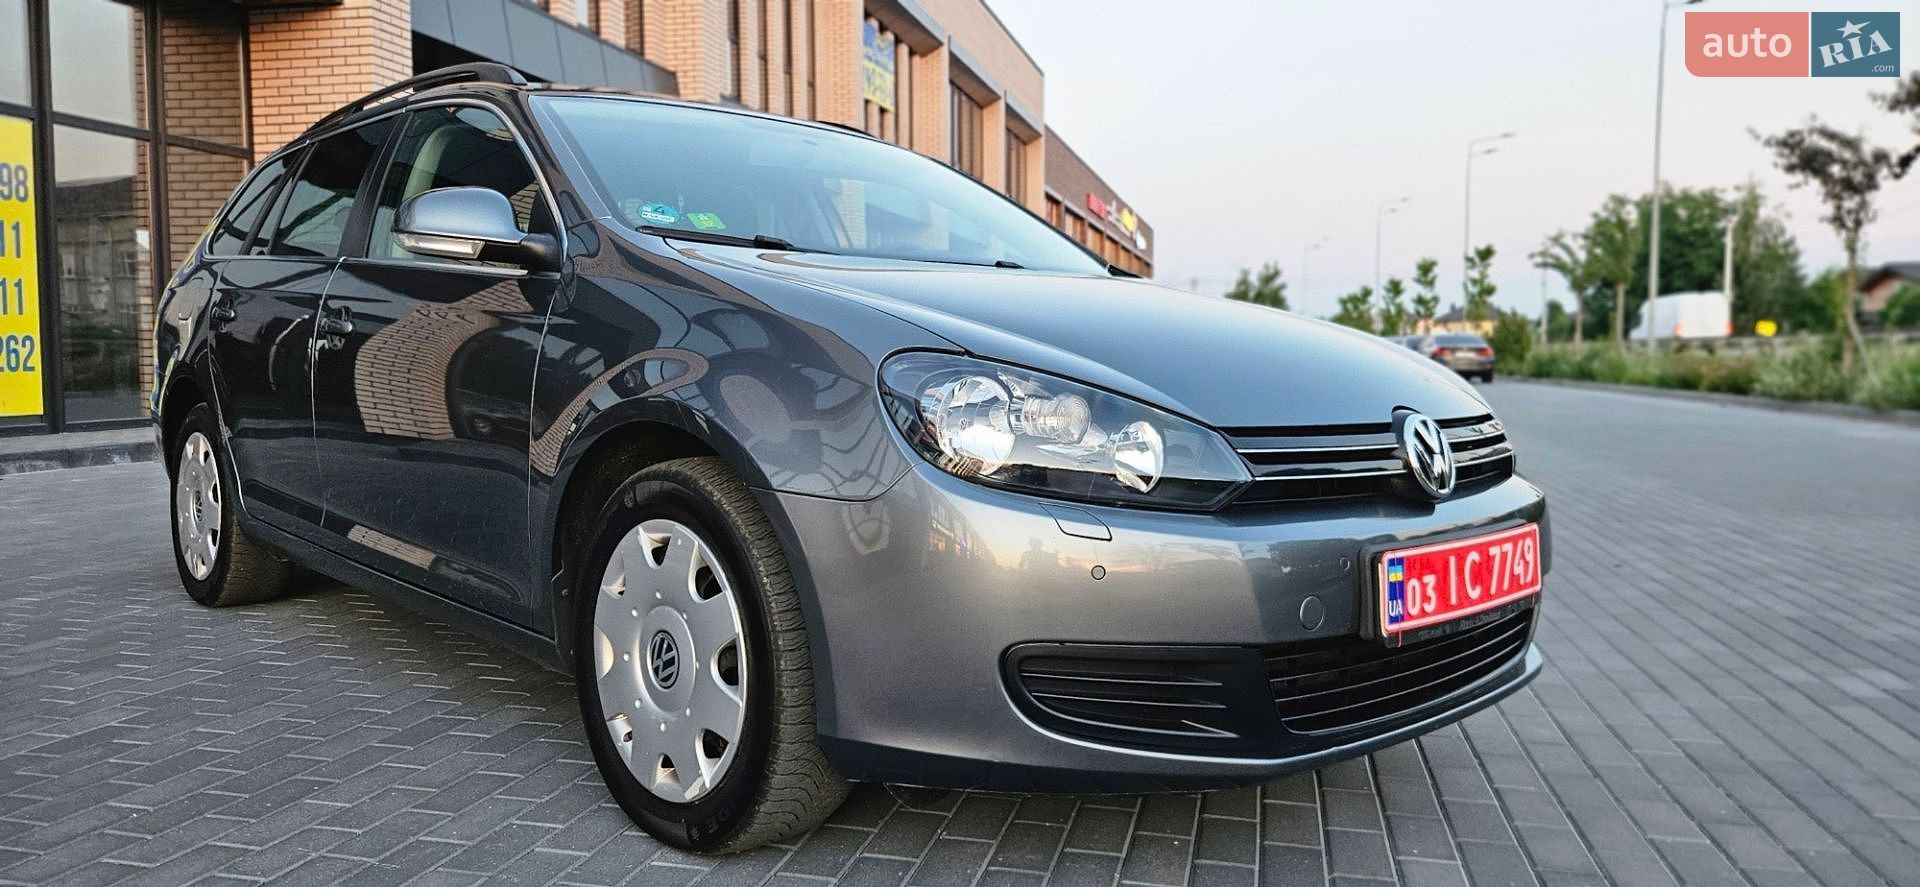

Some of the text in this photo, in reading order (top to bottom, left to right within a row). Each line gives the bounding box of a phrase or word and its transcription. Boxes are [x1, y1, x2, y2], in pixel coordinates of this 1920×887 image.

[0, 163, 29, 203] 98
[1406, 536, 1535, 616] 03 IC 7749
[1388, 598, 1403, 617] UA
